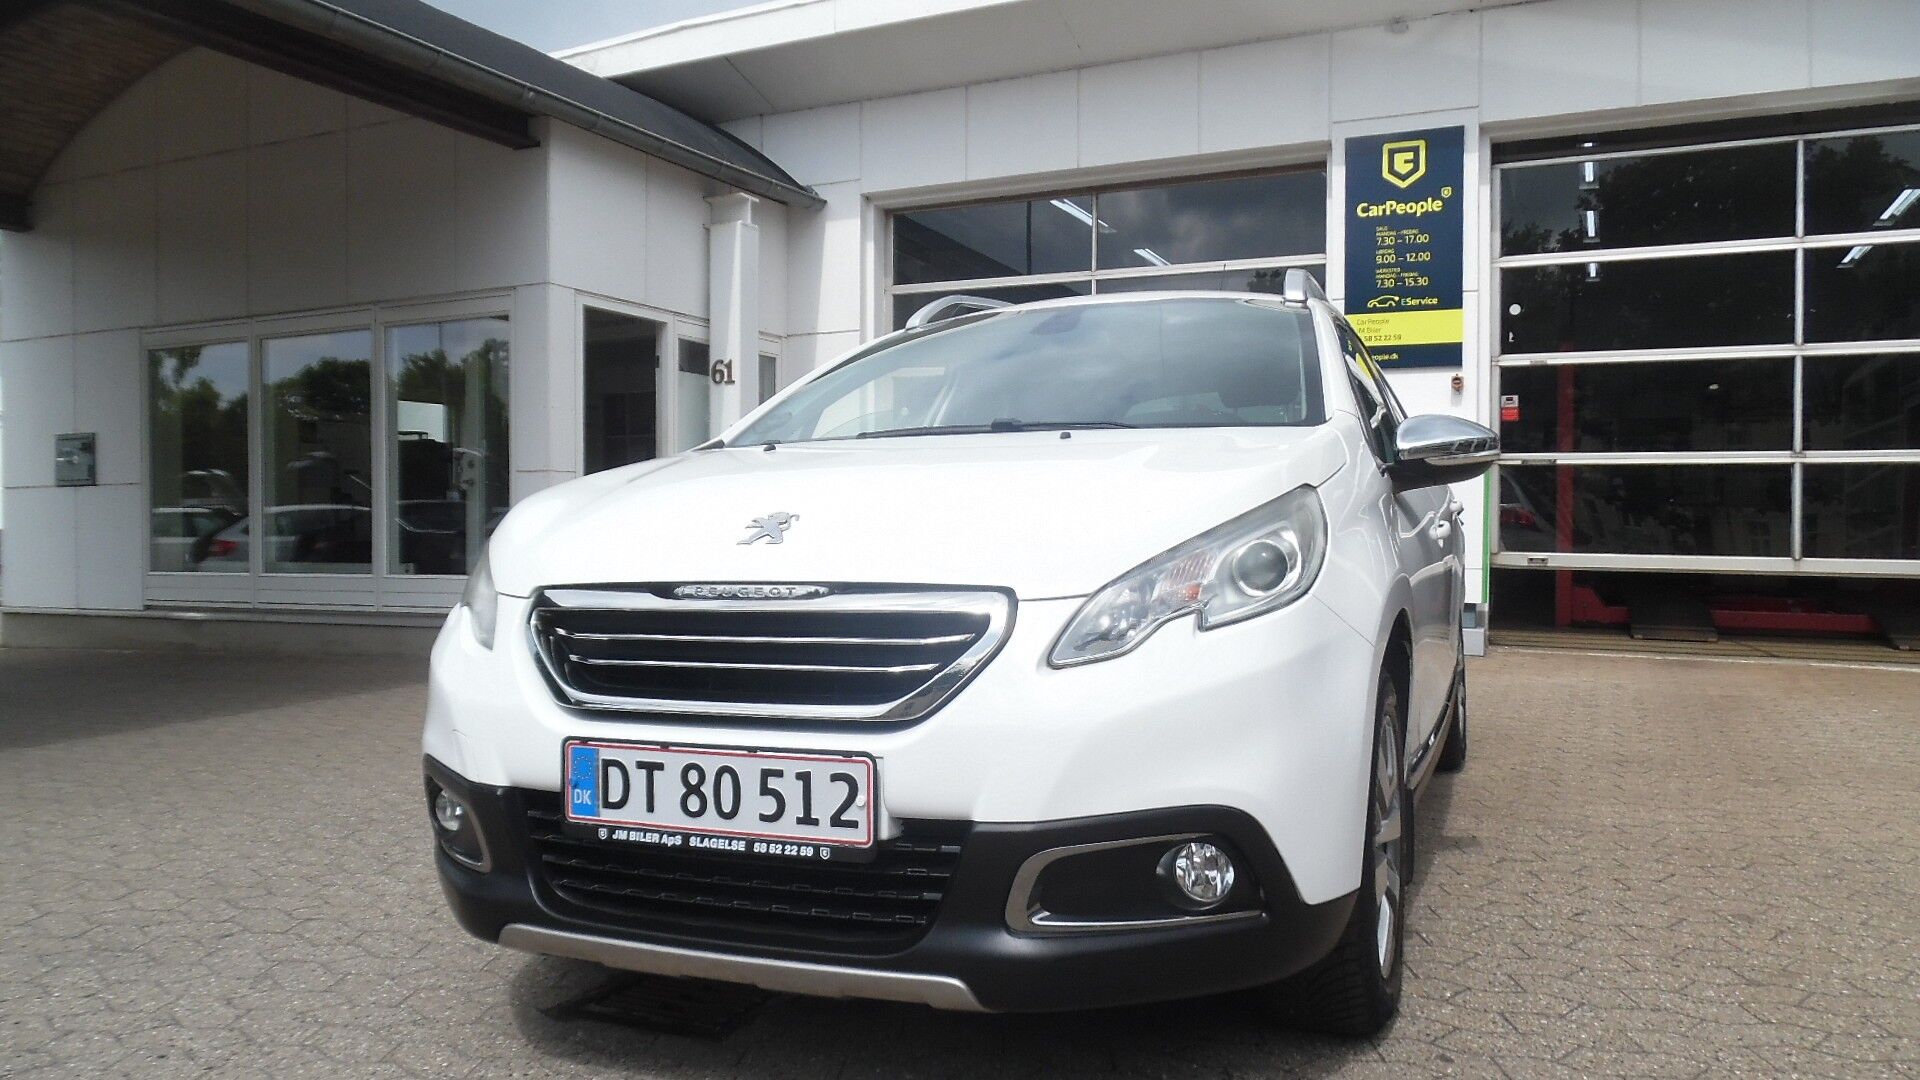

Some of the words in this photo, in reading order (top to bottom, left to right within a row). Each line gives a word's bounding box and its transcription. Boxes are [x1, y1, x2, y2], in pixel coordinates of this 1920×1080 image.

[1356, 197, 1443, 217] CarPeople
[1376, 237, 1396, 246] 7.30
[1405, 234, 1430, 244] 17.00
[1375, 254, 1396, 264] 9.00
[1406, 251, 1431, 262] 12.00
[1376, 279, 1395, 288] 7.30
[1404, 276, 1429, 286] 15.30
[711, 359, 736, 385] 61
[694, 586, 797, 597] PEUGEOT
[574, 788, 592, 805] DK
[601, 758, 665, 813] DT
[679, 762, 742, 820] 80
[758, 768, 859, 829] 512
[612, 829, 628, 840] JM
[629, 831, 660, 844] BILER
[660, 834, 682, 847] ApS
[689, 836, 746, 851] SLAGELSE
[768, 843, 782, 854] 52
[784, 845, 798, 856] 22
[799, 846, 814, 857] 59
